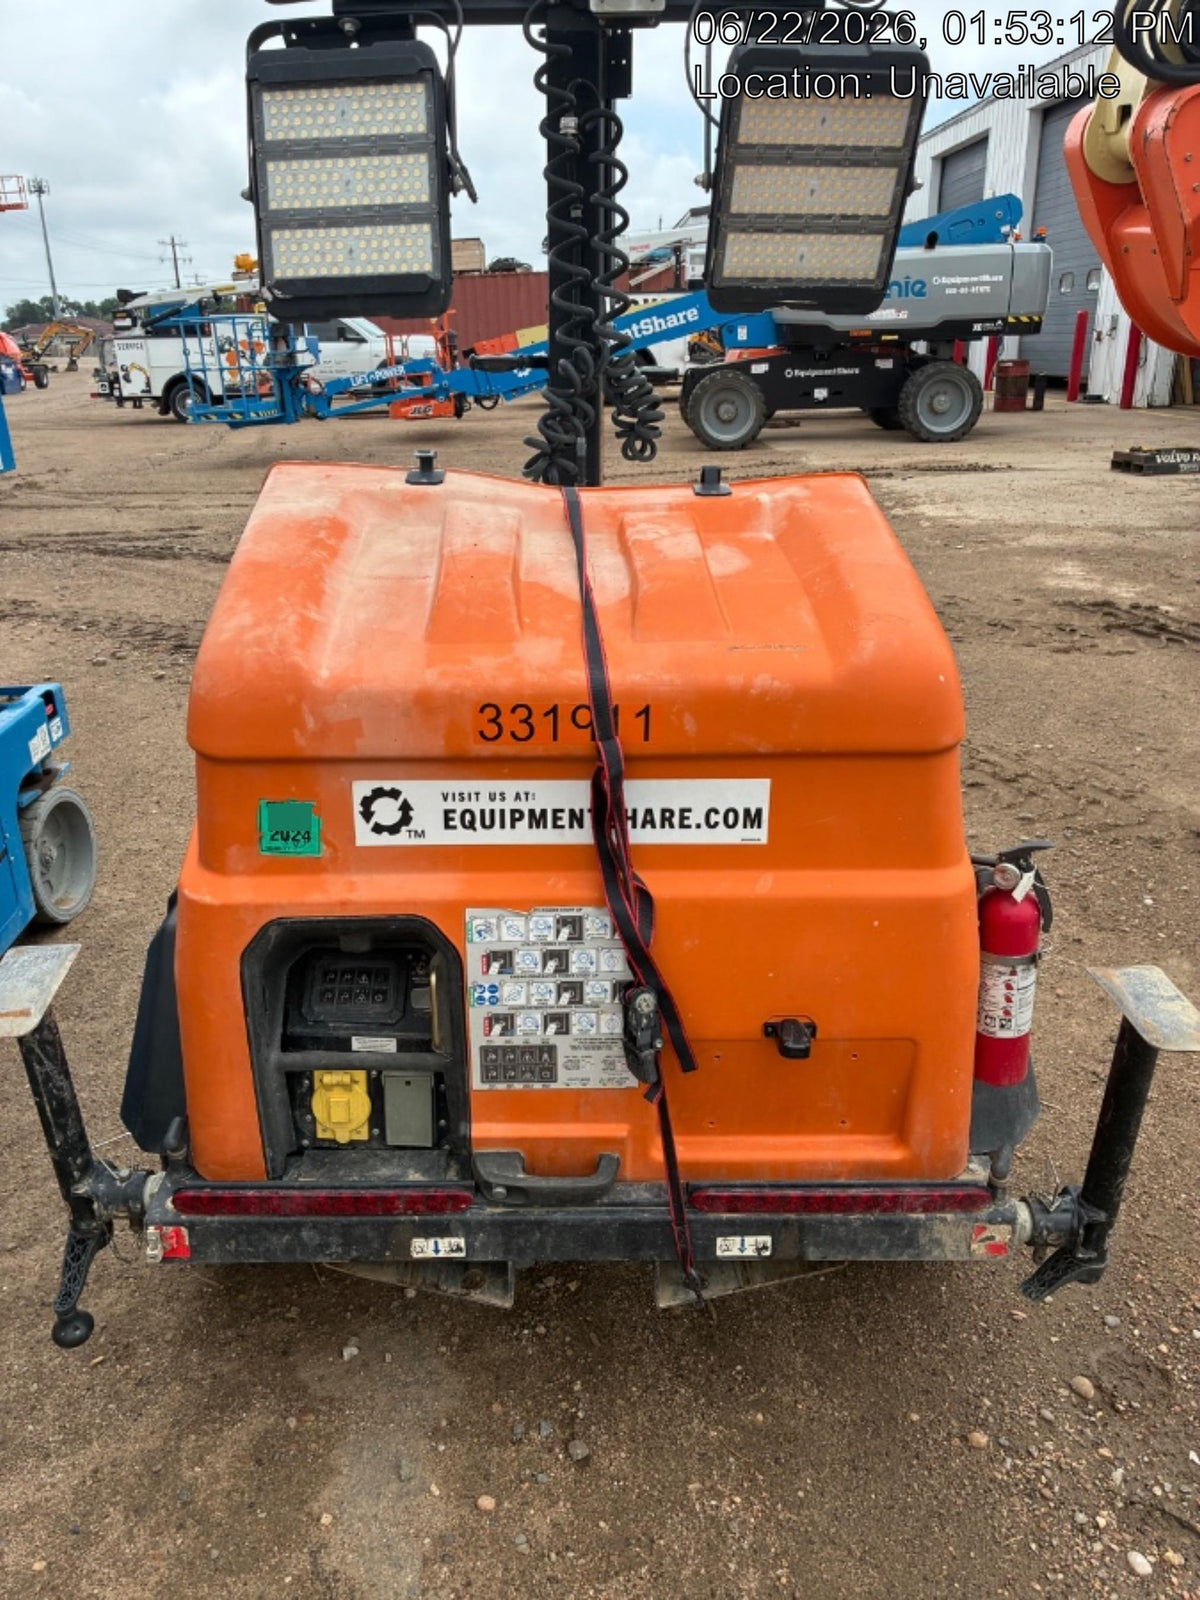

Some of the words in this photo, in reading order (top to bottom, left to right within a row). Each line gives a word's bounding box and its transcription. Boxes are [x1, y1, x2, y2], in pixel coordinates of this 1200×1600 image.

[886, 275, 927, 299] nie
[409, 404, 433, 415] JLG
[441, 791, 480, 802] VISIT
[488, 791, 506, 802] US
[514, 791, 536, 802] AT:
[443, 807, 763, 832] EQUIPMENHARE.COM
[406, 829, 426, 840] TM
